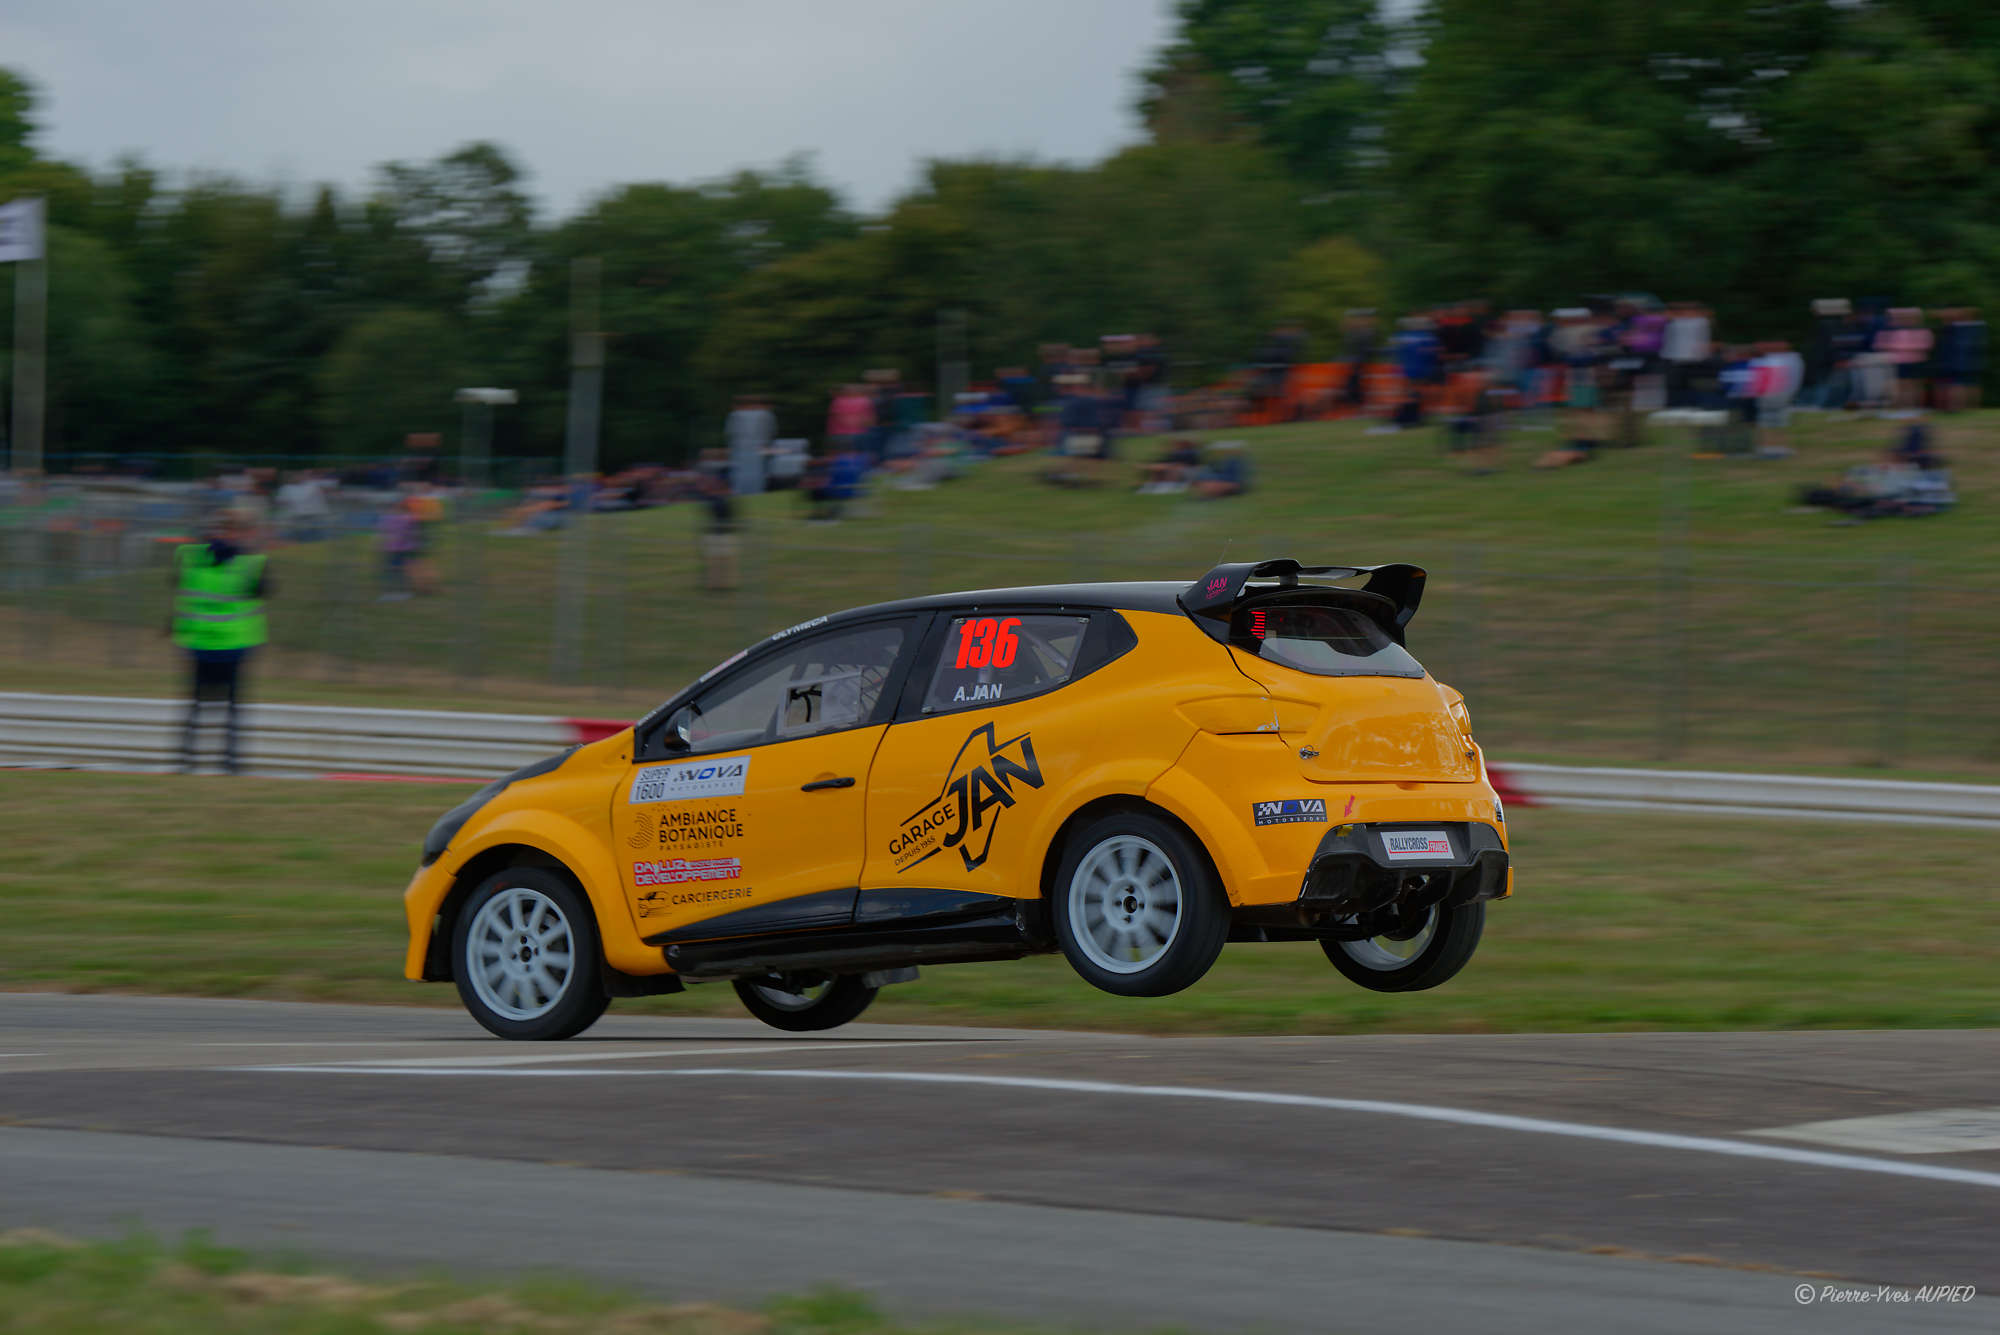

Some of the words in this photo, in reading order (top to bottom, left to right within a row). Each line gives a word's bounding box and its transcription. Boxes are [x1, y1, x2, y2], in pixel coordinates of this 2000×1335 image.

[1207, 577, 1227, 592] JAN
[955, 617, 1022, 669] 136
[953, 683, 1002, 702] A.JAN
[674, 764, 743, 782] NOVA
[636, 782, 665, 800] 1600
[943, 736, 1045, 848] JAN
[1258, 800, 1324, 816] NOVA
[889, 804, 956, 855] GARAGE
[1390, 837, 1428, 851] RALLYCROSS
[635, 866, 740, 885] DEVELOPPEMENT
[672, 887, 753, 904] CARCIERGERIE
